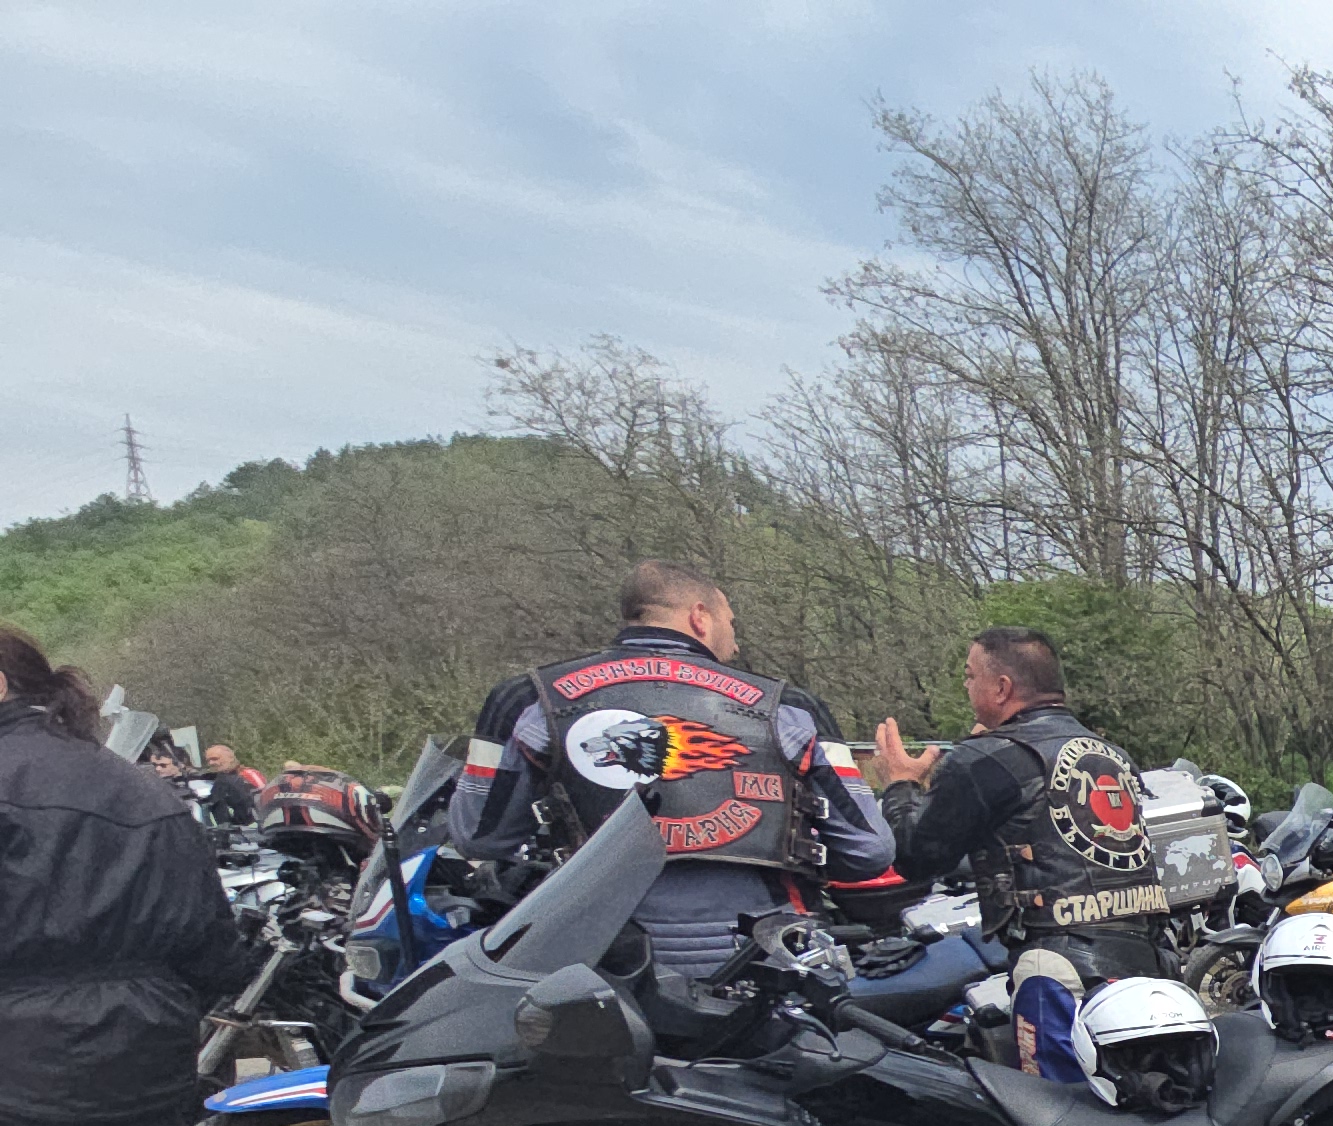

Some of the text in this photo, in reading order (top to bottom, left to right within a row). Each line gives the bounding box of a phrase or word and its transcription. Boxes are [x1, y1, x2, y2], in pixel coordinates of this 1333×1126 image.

[558, 661, 760, 703] НОЧНЫЕ ВОЛКИ
[656, 802, 756, 847] ГАРИЯ
